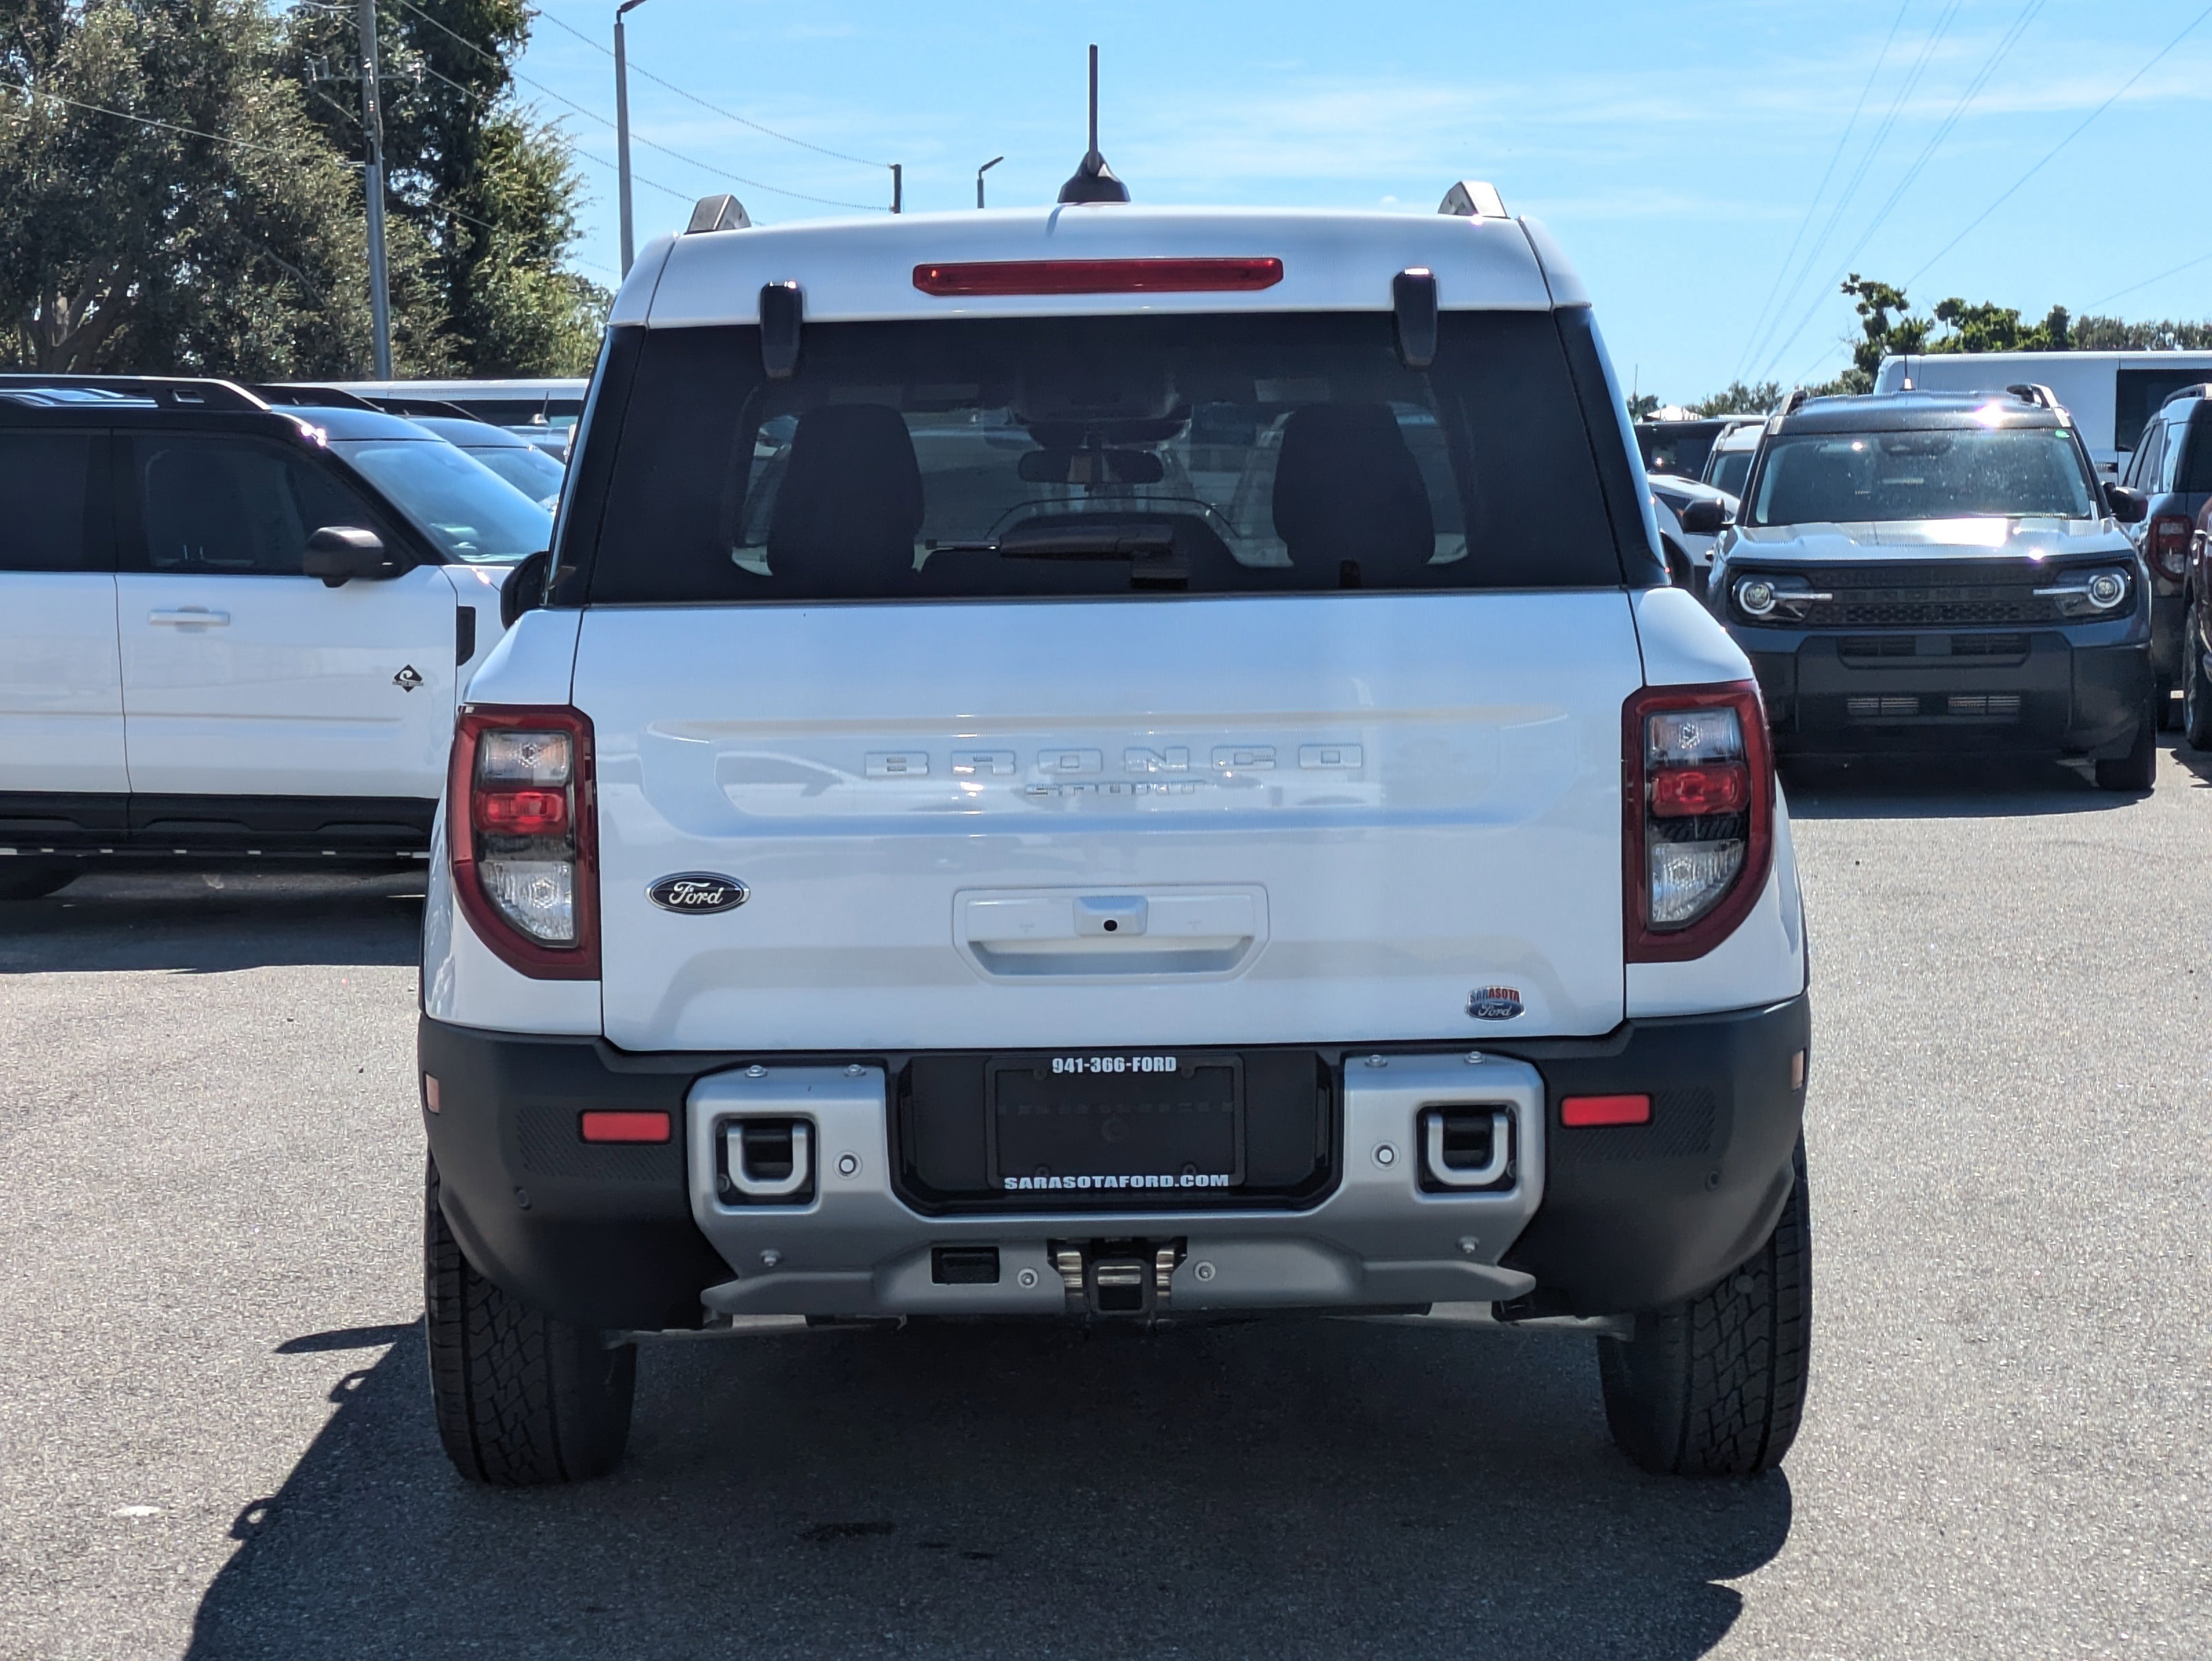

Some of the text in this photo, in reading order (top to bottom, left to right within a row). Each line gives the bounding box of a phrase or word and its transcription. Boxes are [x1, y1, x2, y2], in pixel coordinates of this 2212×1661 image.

[865, 743, 1362, 775] BRONCO
[669, 881, 725, 904] Ford
[1478, 1001, 1513, 1017] Ford
[1052, 1057, 1176, 1073] 941-366-FORD
[1005, 1174, 1229, 1189] SARASOTAFORD.COM
